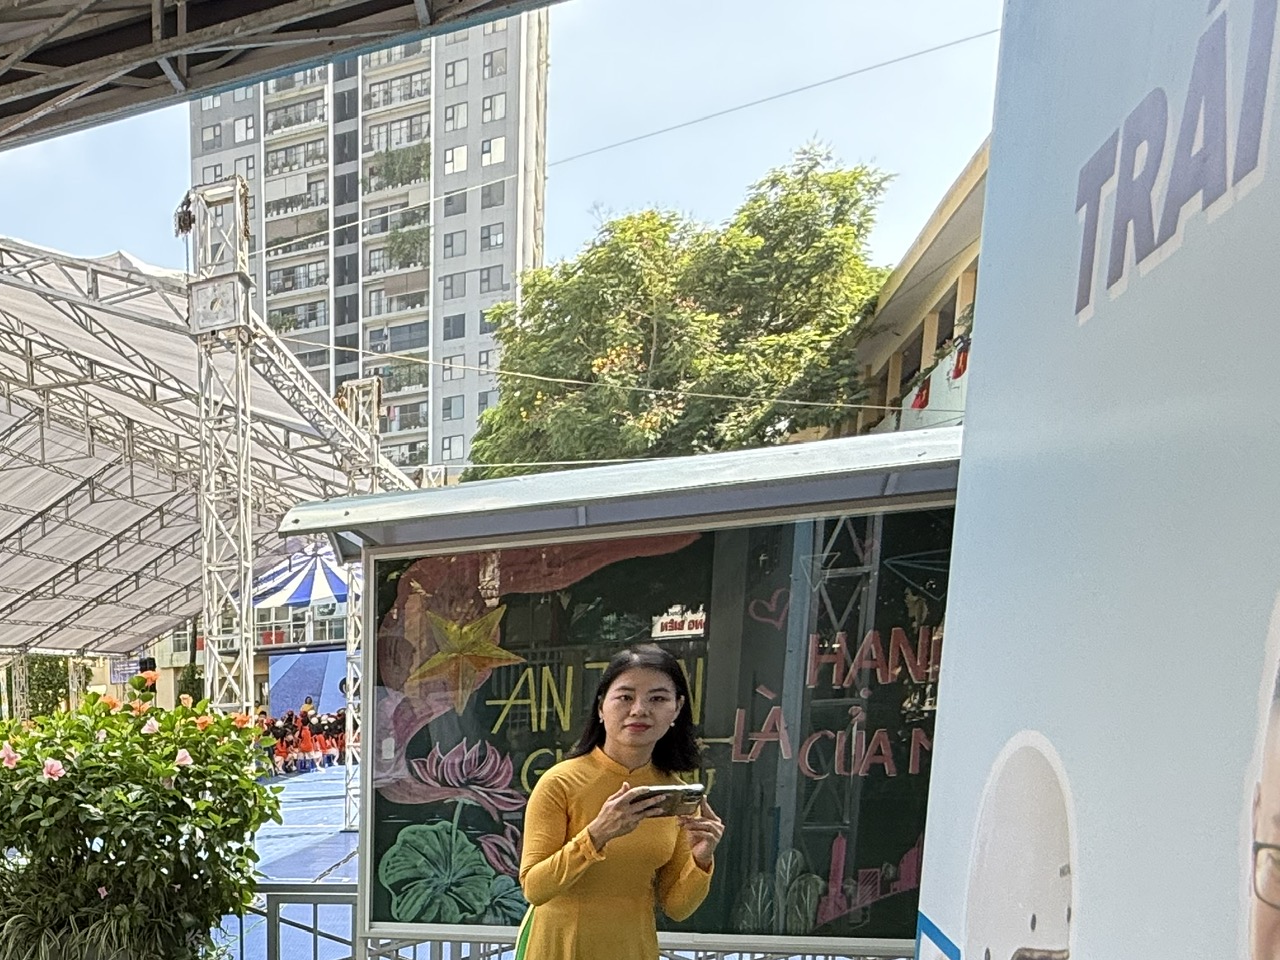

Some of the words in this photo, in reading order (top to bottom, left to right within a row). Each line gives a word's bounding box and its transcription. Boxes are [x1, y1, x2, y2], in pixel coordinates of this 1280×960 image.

[486, 664, 574, 735] AN
[731, 684, 793, 763] LÀ
[798, 705, 898, 780] CỦA
